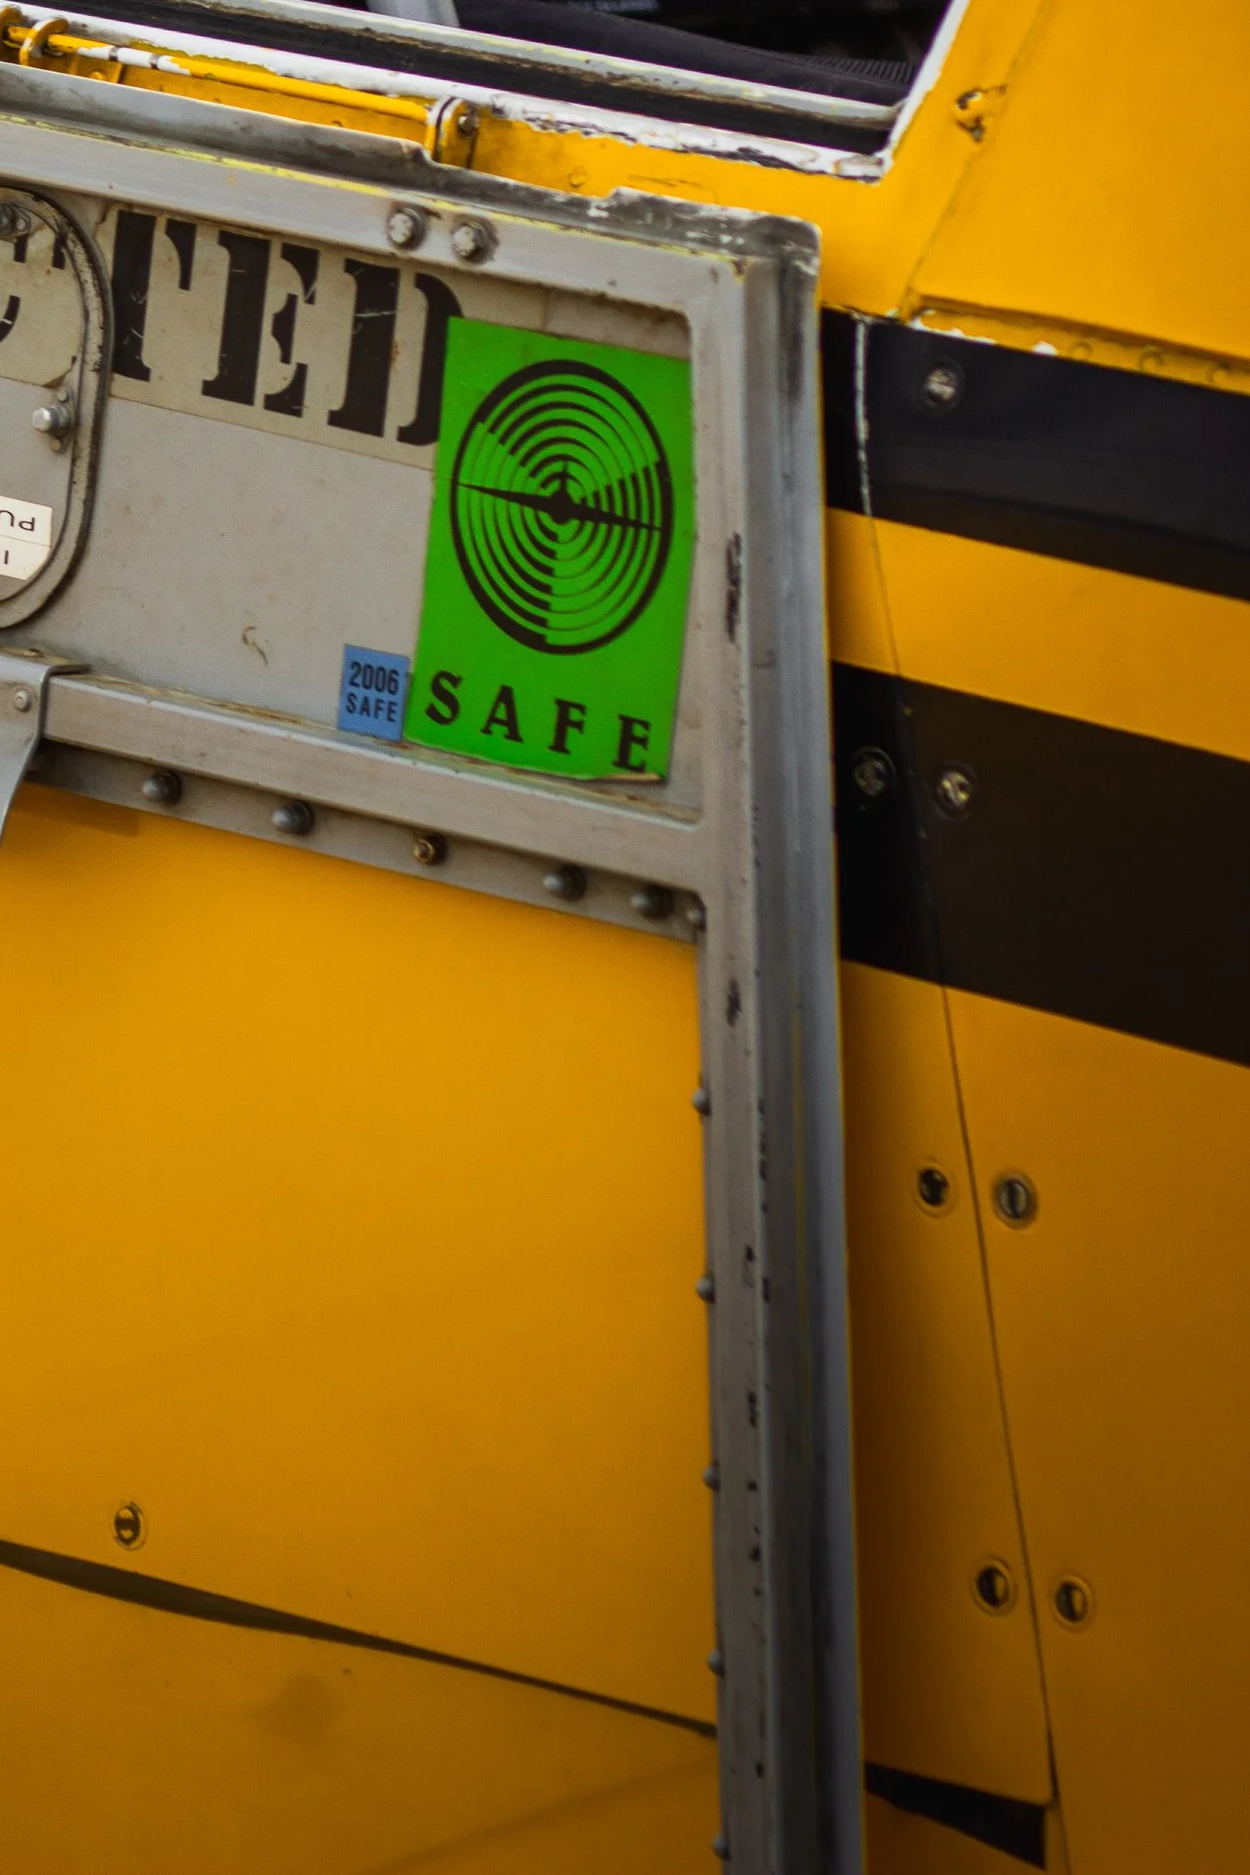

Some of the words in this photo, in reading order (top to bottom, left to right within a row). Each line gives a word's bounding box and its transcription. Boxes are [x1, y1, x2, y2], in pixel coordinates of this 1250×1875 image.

[349, 660, 399, 696] 2006
[345, 692, 398, 724] SAFE
[424, 670, 651, 773] SAFE
